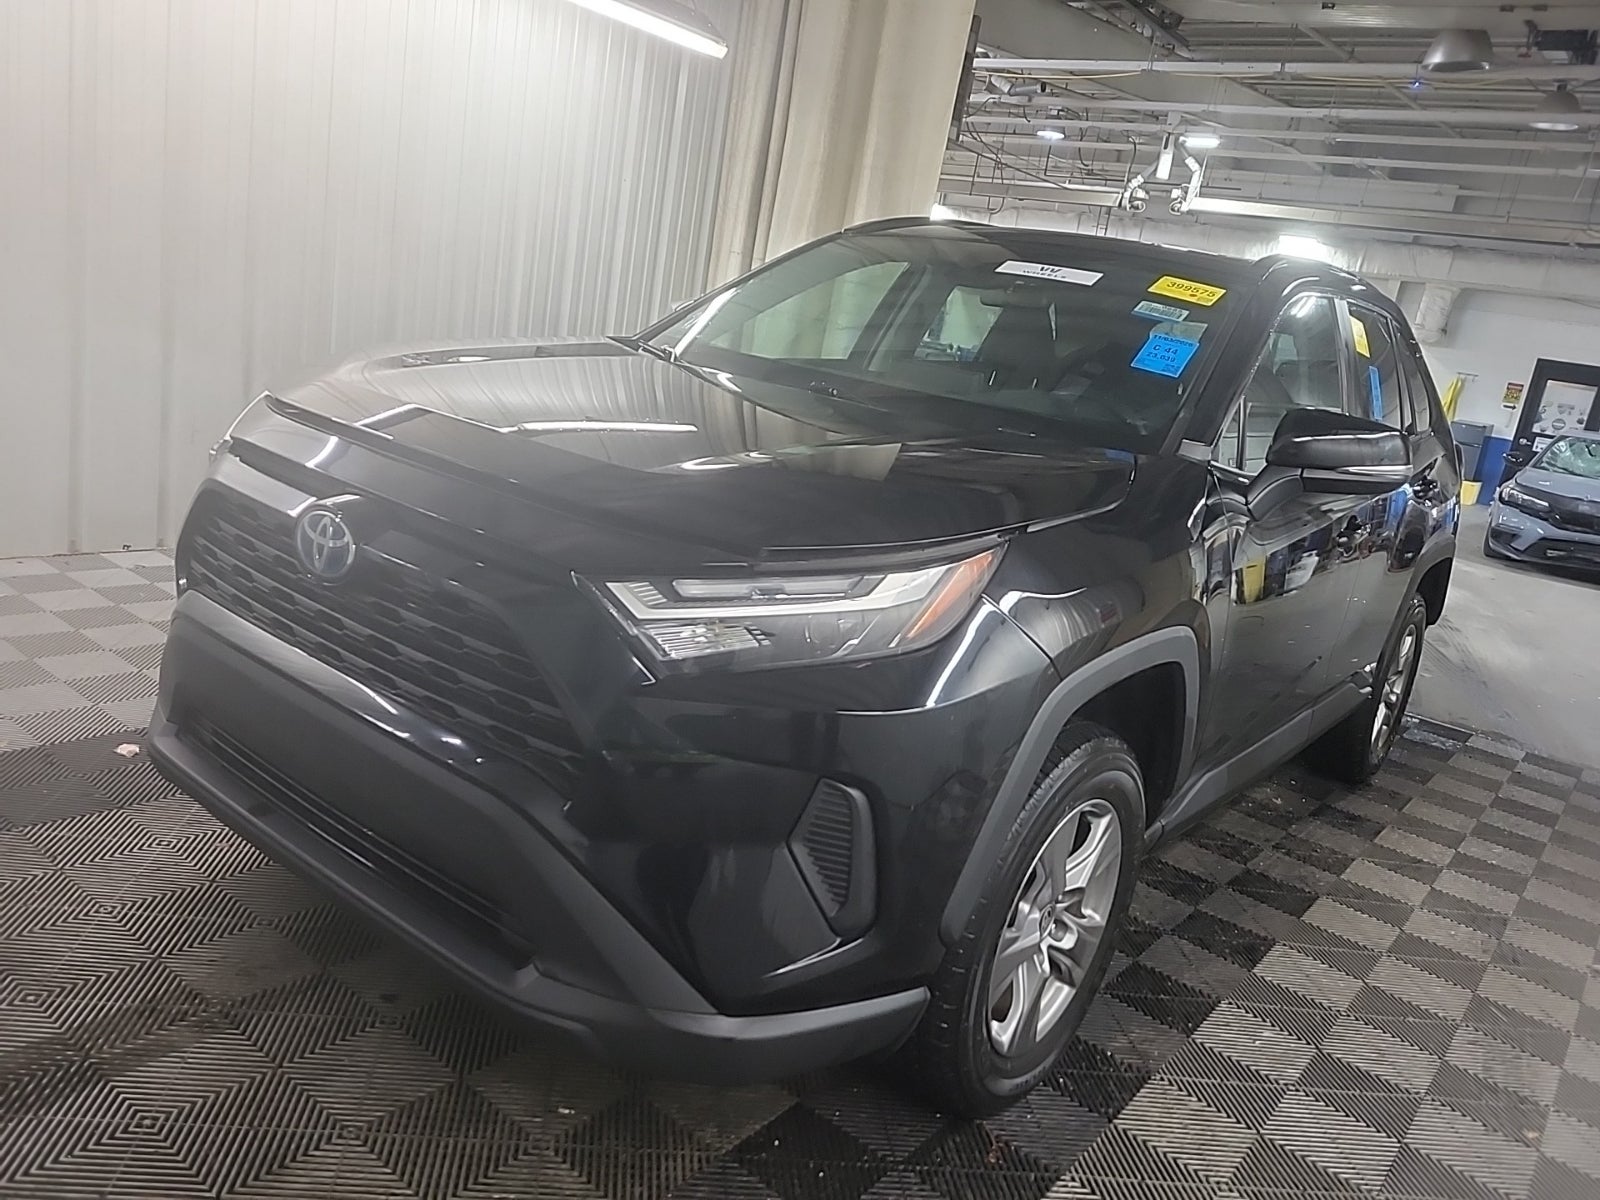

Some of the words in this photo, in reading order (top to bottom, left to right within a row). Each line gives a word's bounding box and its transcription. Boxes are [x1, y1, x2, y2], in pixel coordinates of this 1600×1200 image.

[1022, 270, 1067, 279] WHEELS
[1166, 281, 1217, 298] 399575
[1165, 347, 1178, 355] 44
